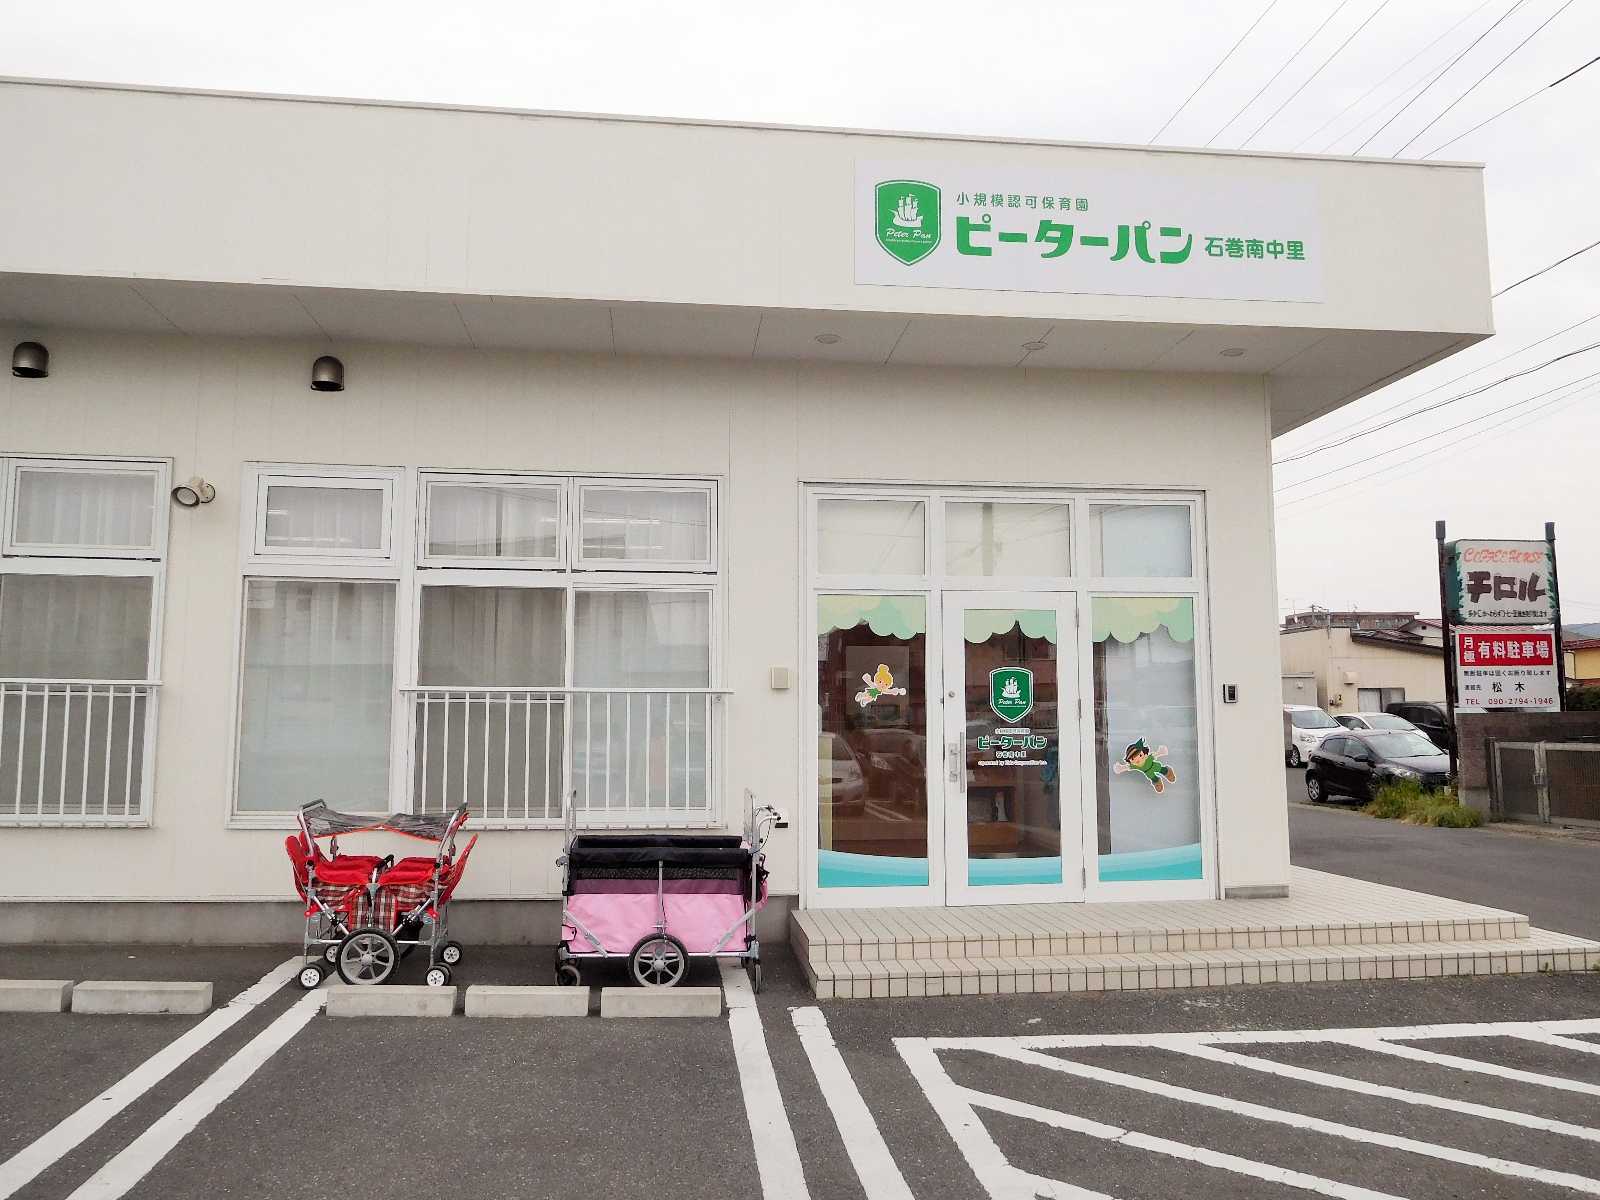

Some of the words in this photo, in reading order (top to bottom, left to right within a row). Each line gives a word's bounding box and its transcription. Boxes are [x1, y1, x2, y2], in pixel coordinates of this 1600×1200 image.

[956, 191, 1088, 211] 小規模認可保育園
[956, 213, 1192, 264] ピーターパン
[1204, 236, 1305, 261] 石巻南中里
[1466, 571, 1547, 603] チロル
[1477, 640, 1549, 659] 有料駐車場
[977, 735, 1047, 750] ピーターパン
